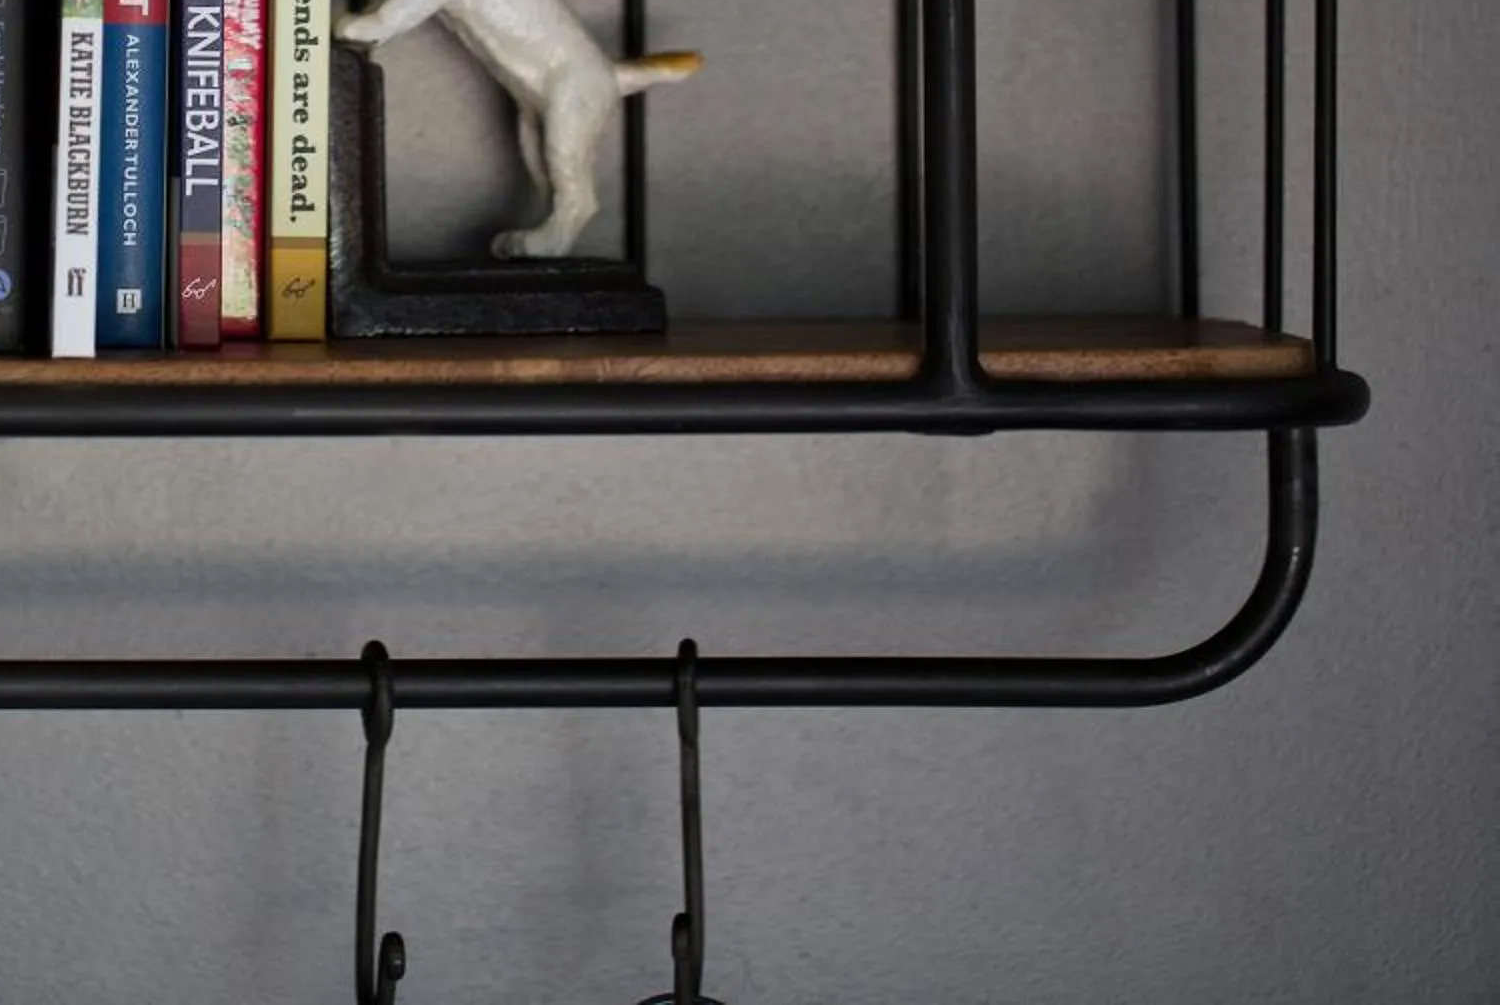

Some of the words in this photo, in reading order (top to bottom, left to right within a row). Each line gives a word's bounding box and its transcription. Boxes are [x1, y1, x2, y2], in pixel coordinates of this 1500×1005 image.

[70, 32, 94, 99] KATIE
[124, 34, 141, 150] ALEXANDER
[185, 5, 222, 196] KNIFEBALL
[293, 73, 311, 123] are
[67, 106, 93, 236] BLACKBURN
[124, 153, 139, 246] TULLOCH
[290, 135, 315, 223] dead.
